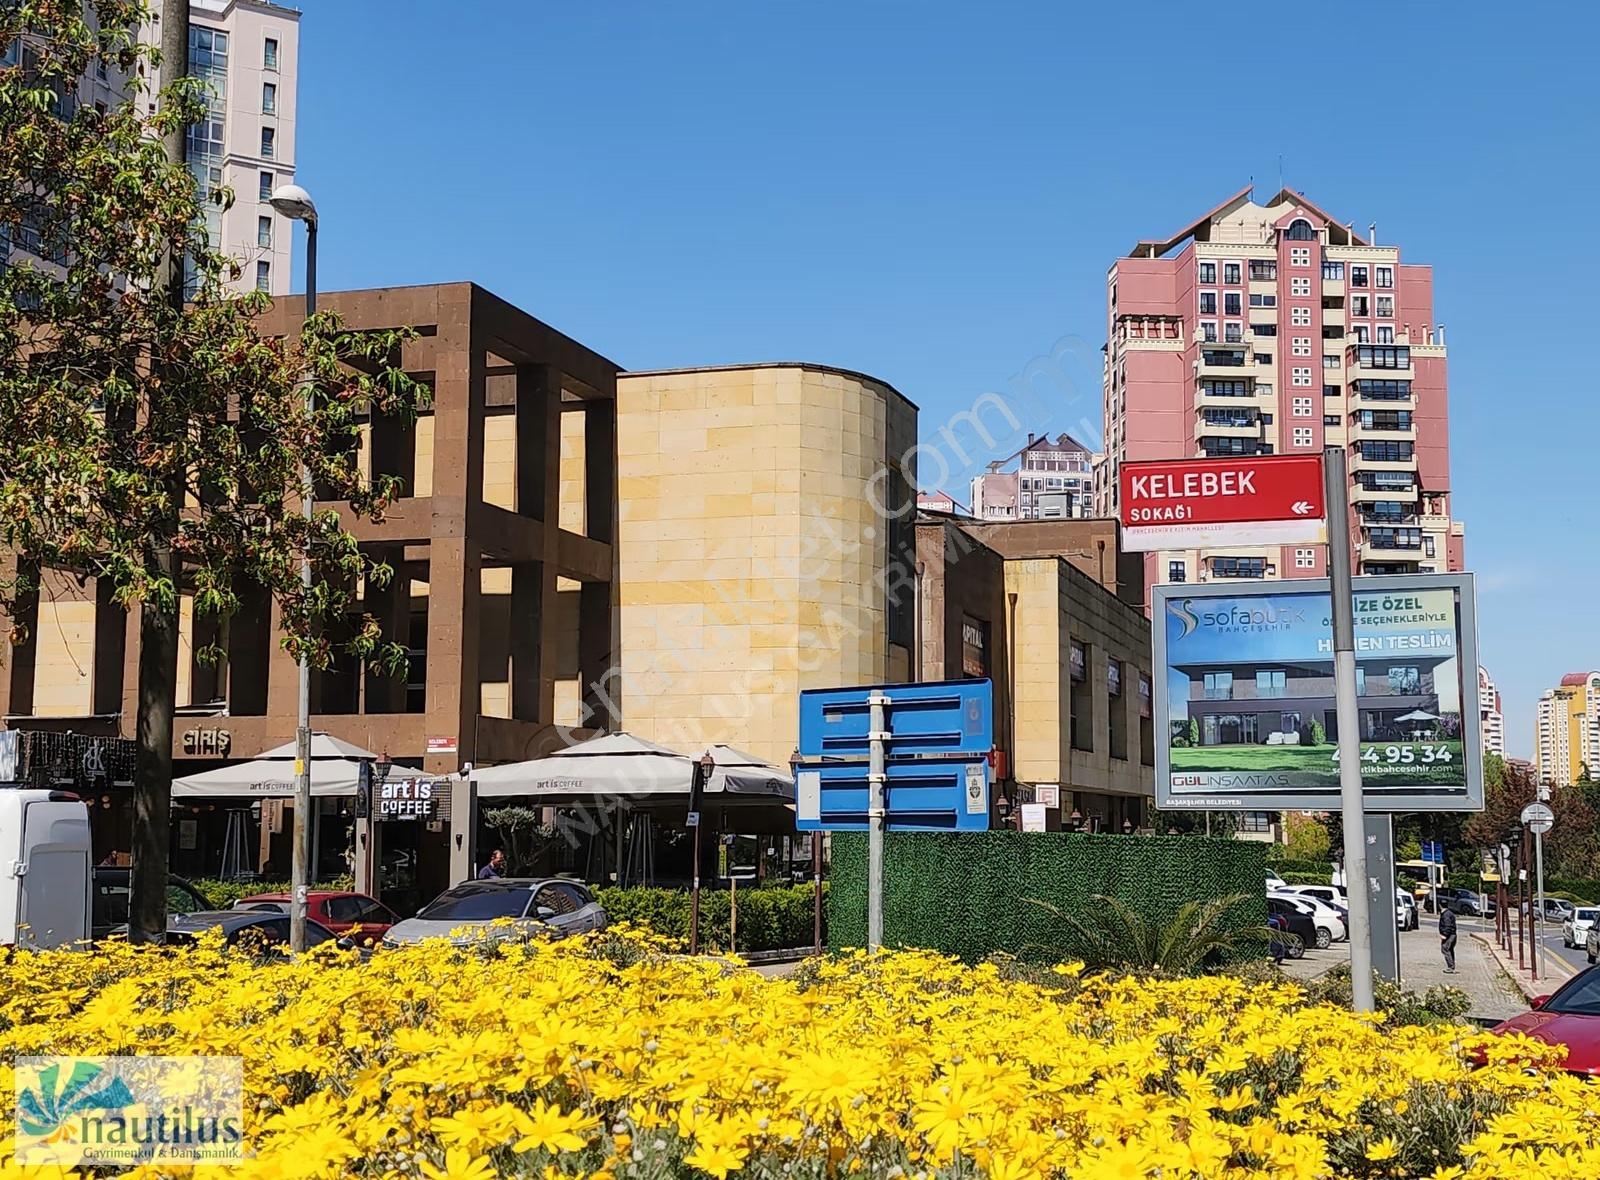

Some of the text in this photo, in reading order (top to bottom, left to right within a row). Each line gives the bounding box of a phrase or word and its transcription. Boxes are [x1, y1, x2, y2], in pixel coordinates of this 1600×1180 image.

[1131, 470, 1257, 500] KELEBEK
[1130, 504, 1192, 522] SOKAĞI
[1382, 595, 1423, 611] ÖZEL
[1360, 612, 1447, 626] SEÇENEKLERİYLE
[1385, 629, 1452, 649] TESLİM
[1384, 745, 1415, 763] 95
[1420, 745, 1453, 763] 34
[381, 800, 431, 815] COFFEE
